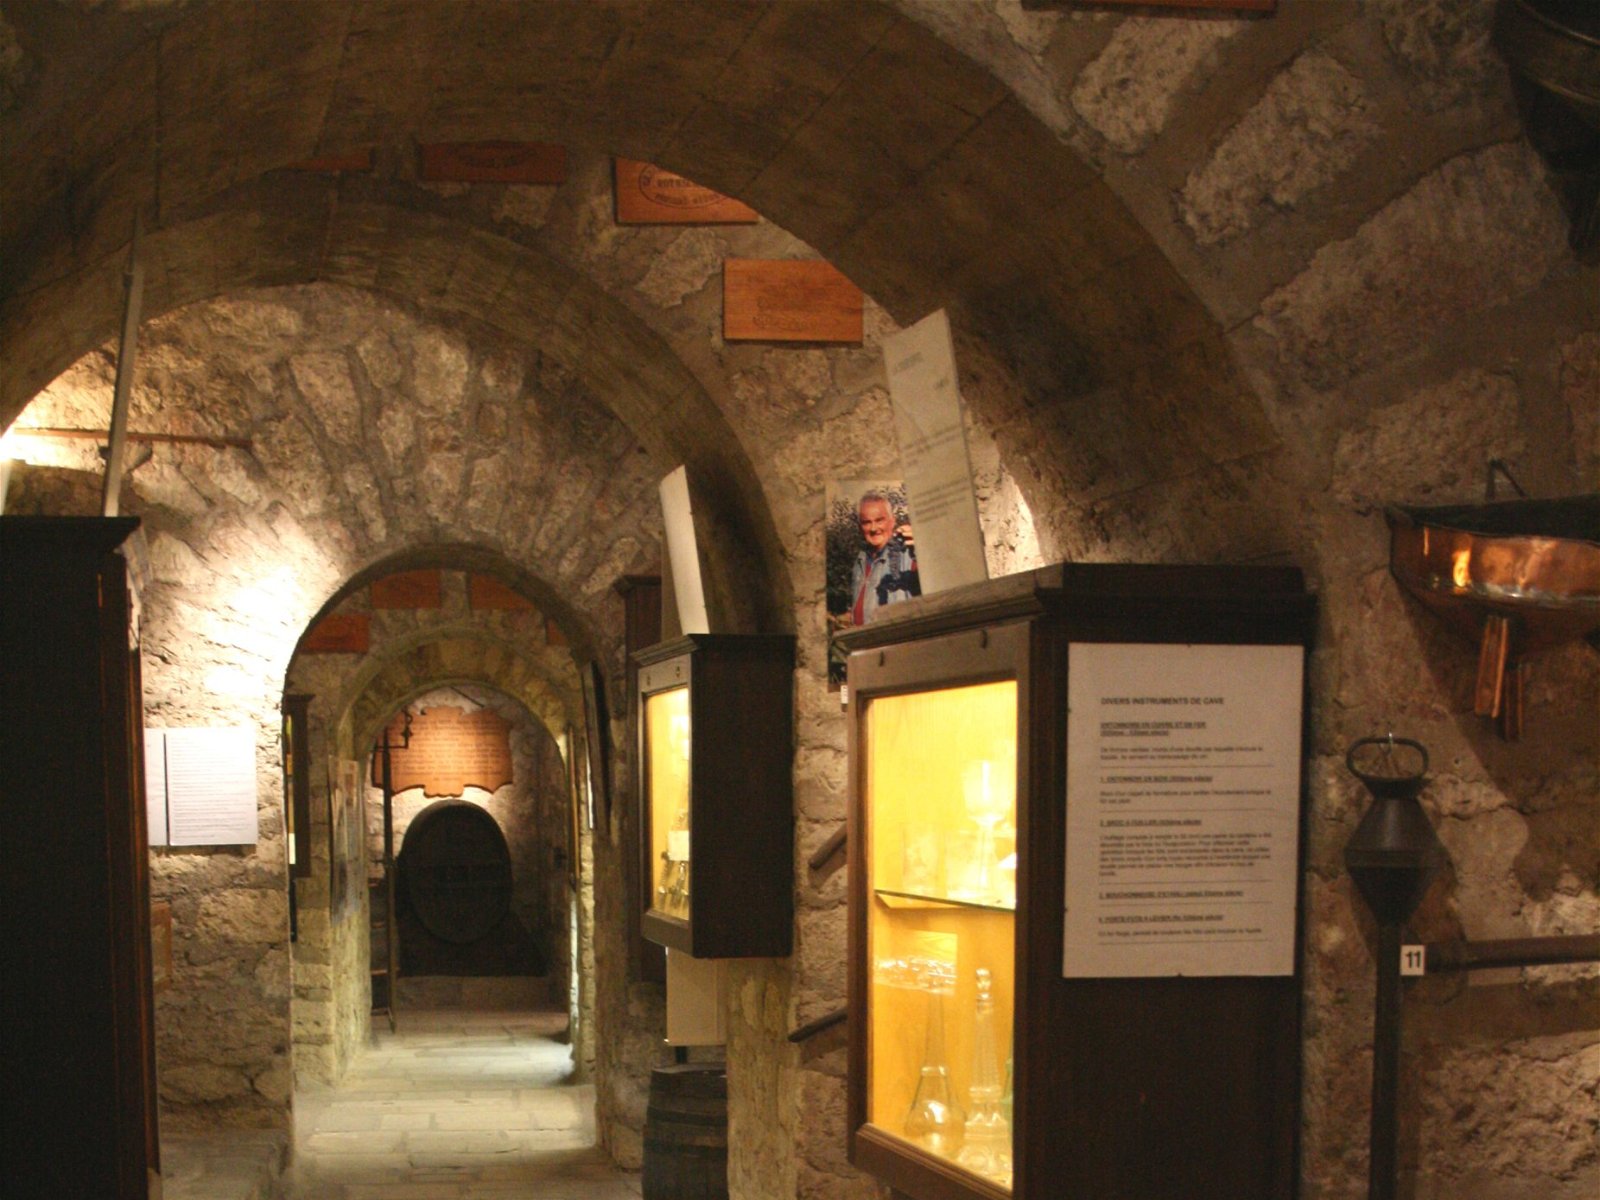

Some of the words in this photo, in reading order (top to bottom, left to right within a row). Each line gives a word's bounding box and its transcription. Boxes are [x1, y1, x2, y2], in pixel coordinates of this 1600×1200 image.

[1101, 697, 1130, 705] DIVERS
[1132, 697, 1188, 705] INSTRUMENTS
[1190, 697, 1202, 705] DE
[1203, 697, 1224, 705] CAVE
[1405, 951, 1421, 968] 11
